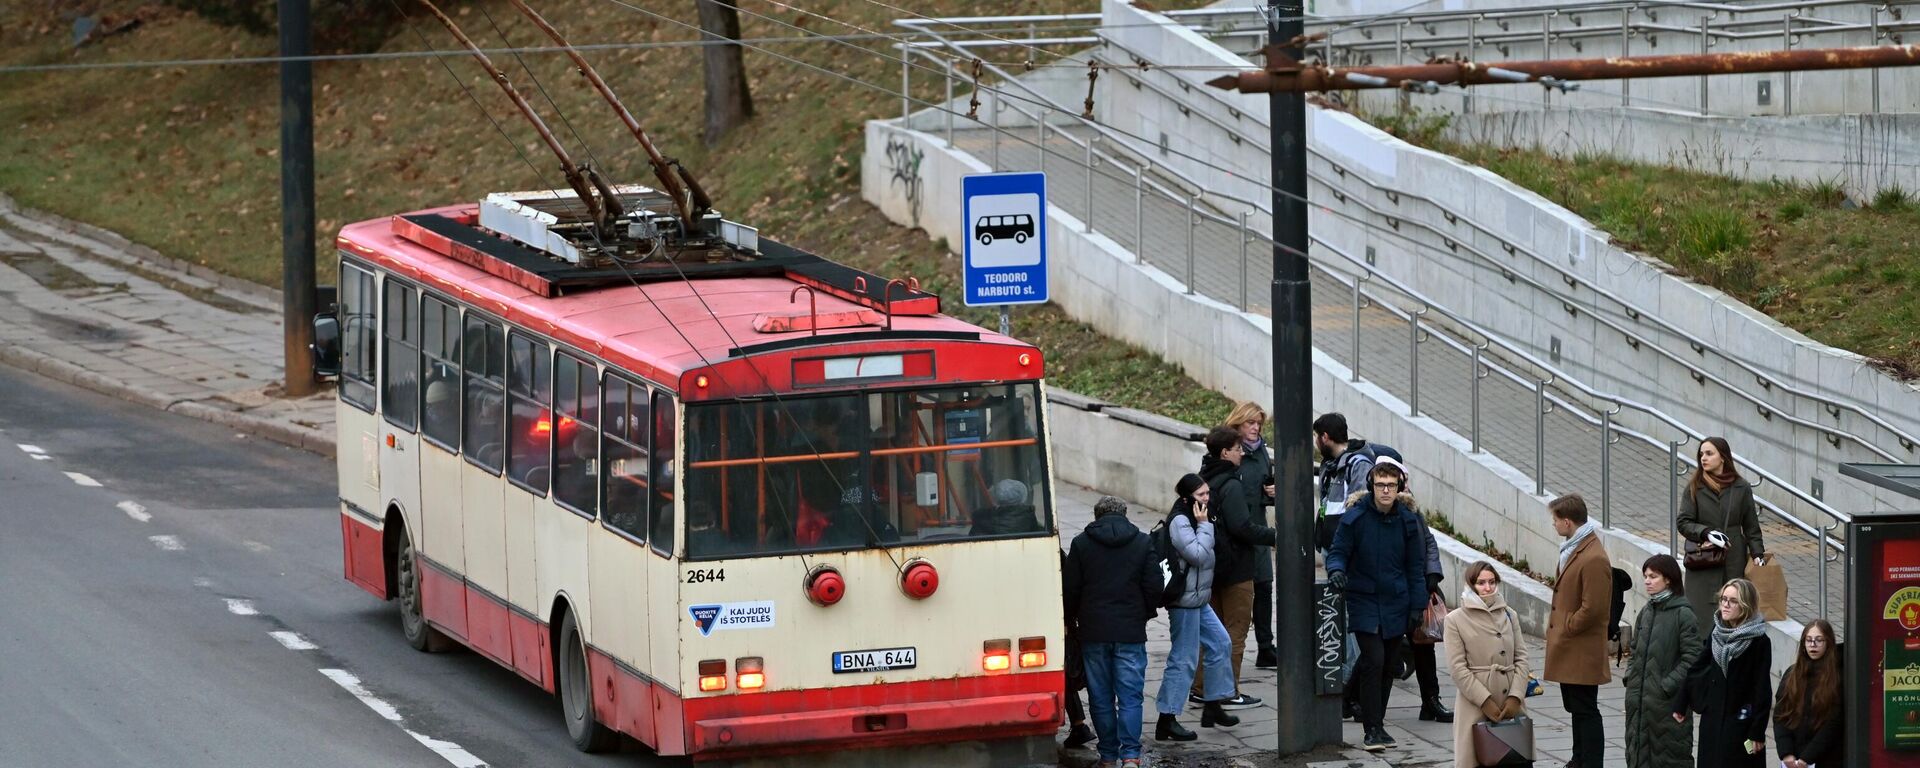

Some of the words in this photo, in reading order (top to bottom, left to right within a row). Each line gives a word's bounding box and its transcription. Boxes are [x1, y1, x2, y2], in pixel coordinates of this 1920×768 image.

[984, 272, 1027, 283] TEODORO
[978, 286, 1021, 296] NARBUTO
[1023, 285, 1035, 295] st.
[687, 568, 725, 583] 2644
[747, 606, 771, 615] JUDU
[720, 616, 728, 624] IŠ
[730, 615, 771, 624] STOTELĖS
[843, 653, 875, 668] BNA
[885, 651, 912, 665] 644
